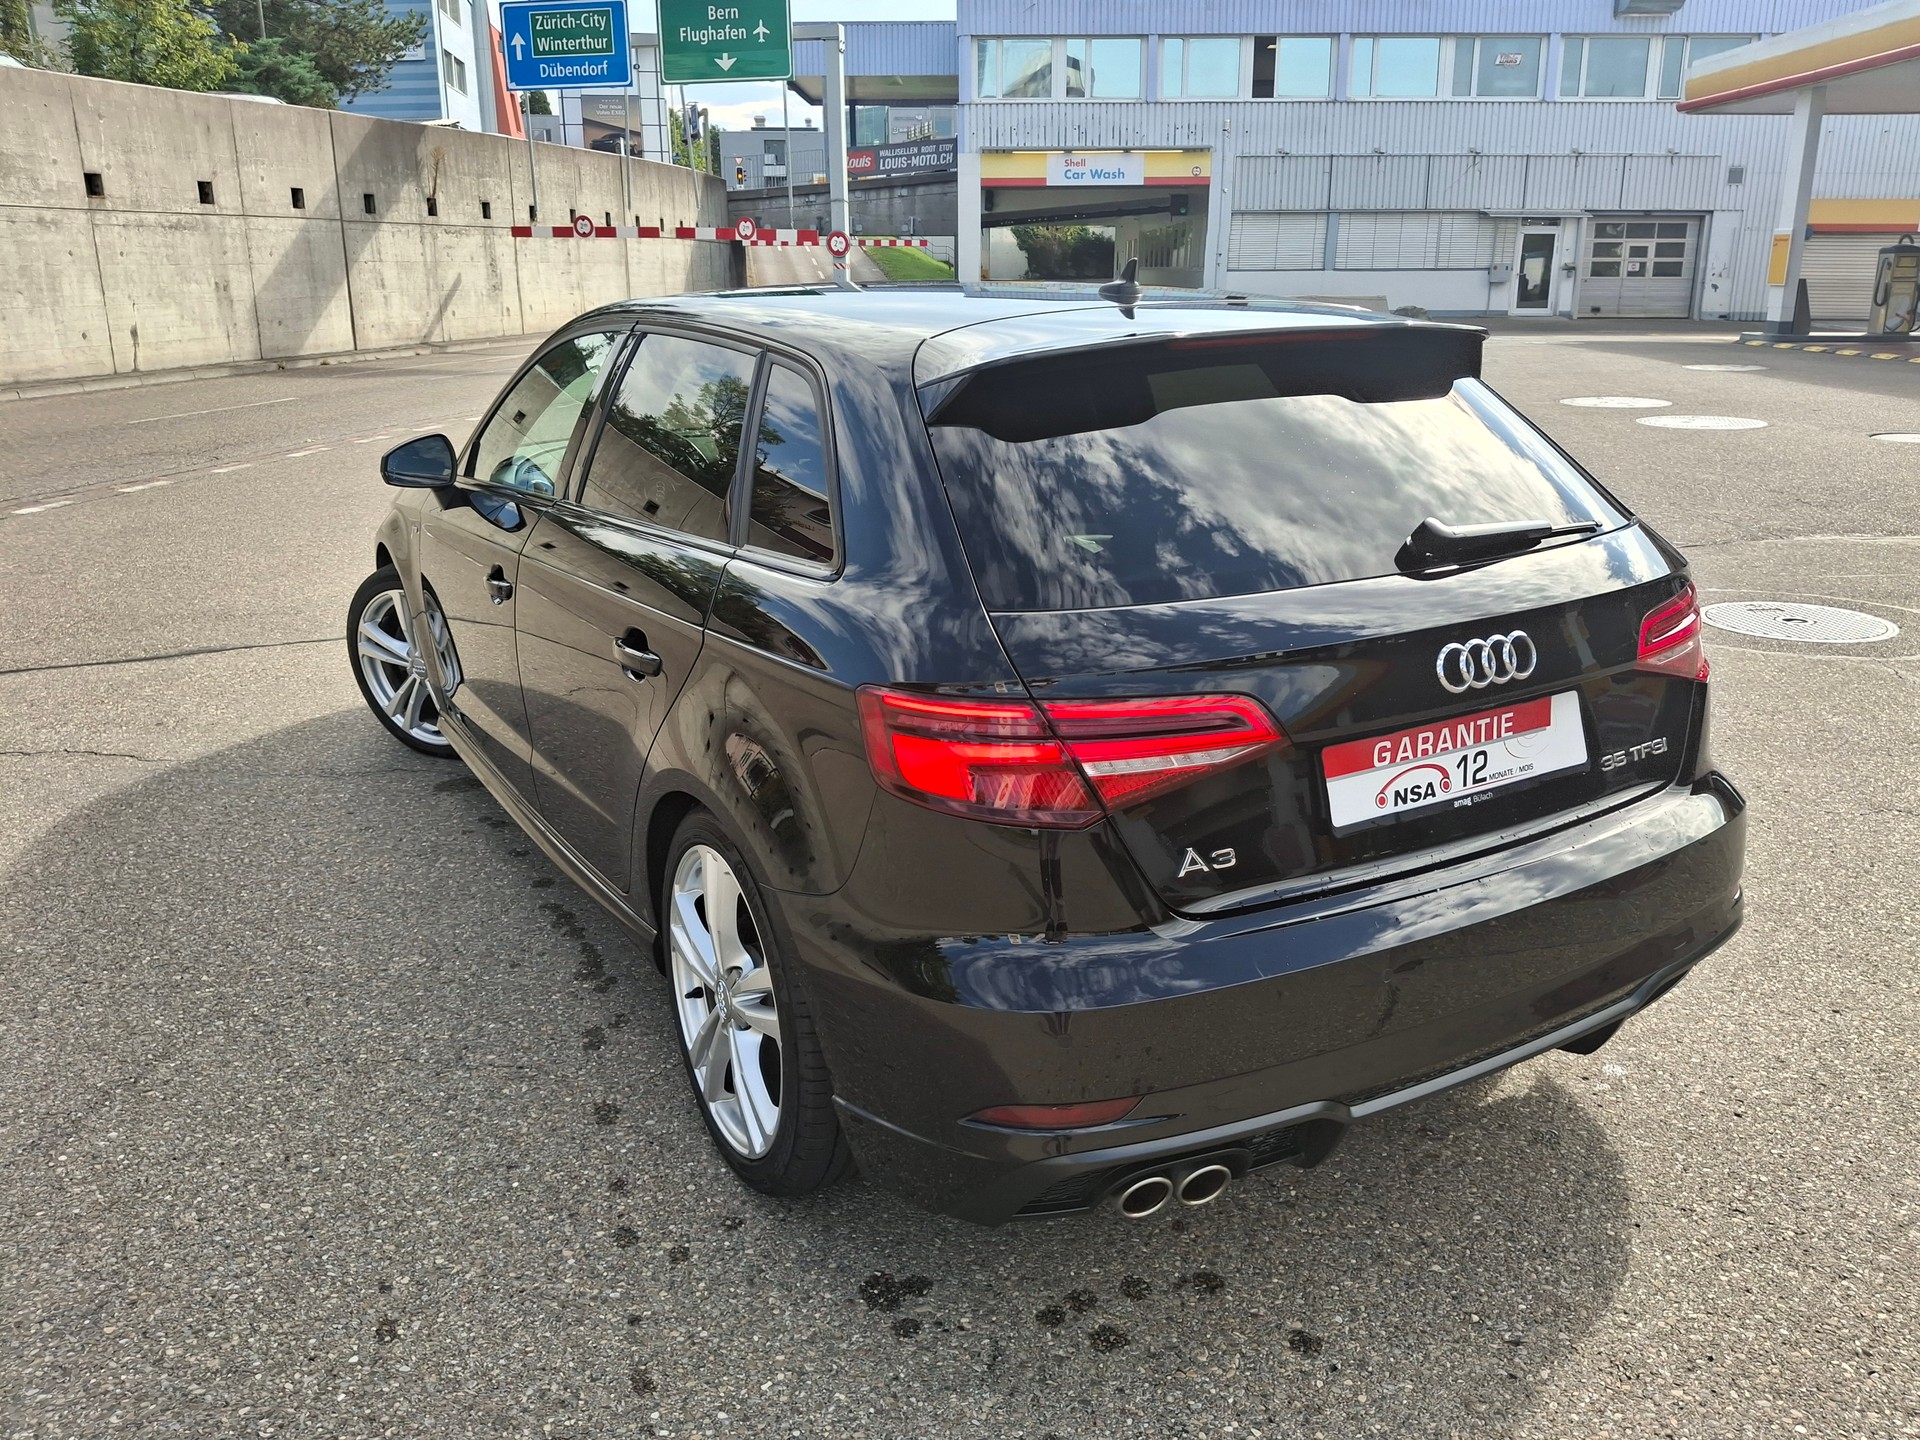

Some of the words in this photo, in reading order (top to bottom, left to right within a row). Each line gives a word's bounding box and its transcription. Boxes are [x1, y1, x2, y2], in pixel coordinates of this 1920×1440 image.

[707, 5, 739, 20] Bern
[535, 13, 607, 31] Zürich-City
[536, 34, 608, 52] Winterthur
[680, 24, 747, 45] Flughafen
[539, 60, 608, 78] Dübendorf
[879, 146, 919, 157] WALLISELLEN
[920, 144, 937, 153] ROOT
[938, 143, 954, 152] ETOY
[879, 152, 953, 170] LOUIS-MOTO.CH
[1064, 158, 1086, 168] Shell
[1064, 168, 1086, 180] Car
[1090, 167, 1125, 180] Wash
[1373, 712, 1515, 769] GARANTIE
[1600, 750, 1628, 772] 35
[1629, 737, 1668, 761] TFSI
[1456, 749, 1489, 788] 12
[1488, 767, 1515, 781] MONATE
[1518, 762, 1534, 773] MOIS
[1393, 781, 1437, 808] NSA
[1453, 796, 1473, 808] amag
[1472, 791, 1494, 803] Bülach
[1177, 847, 1237, 878] A3
